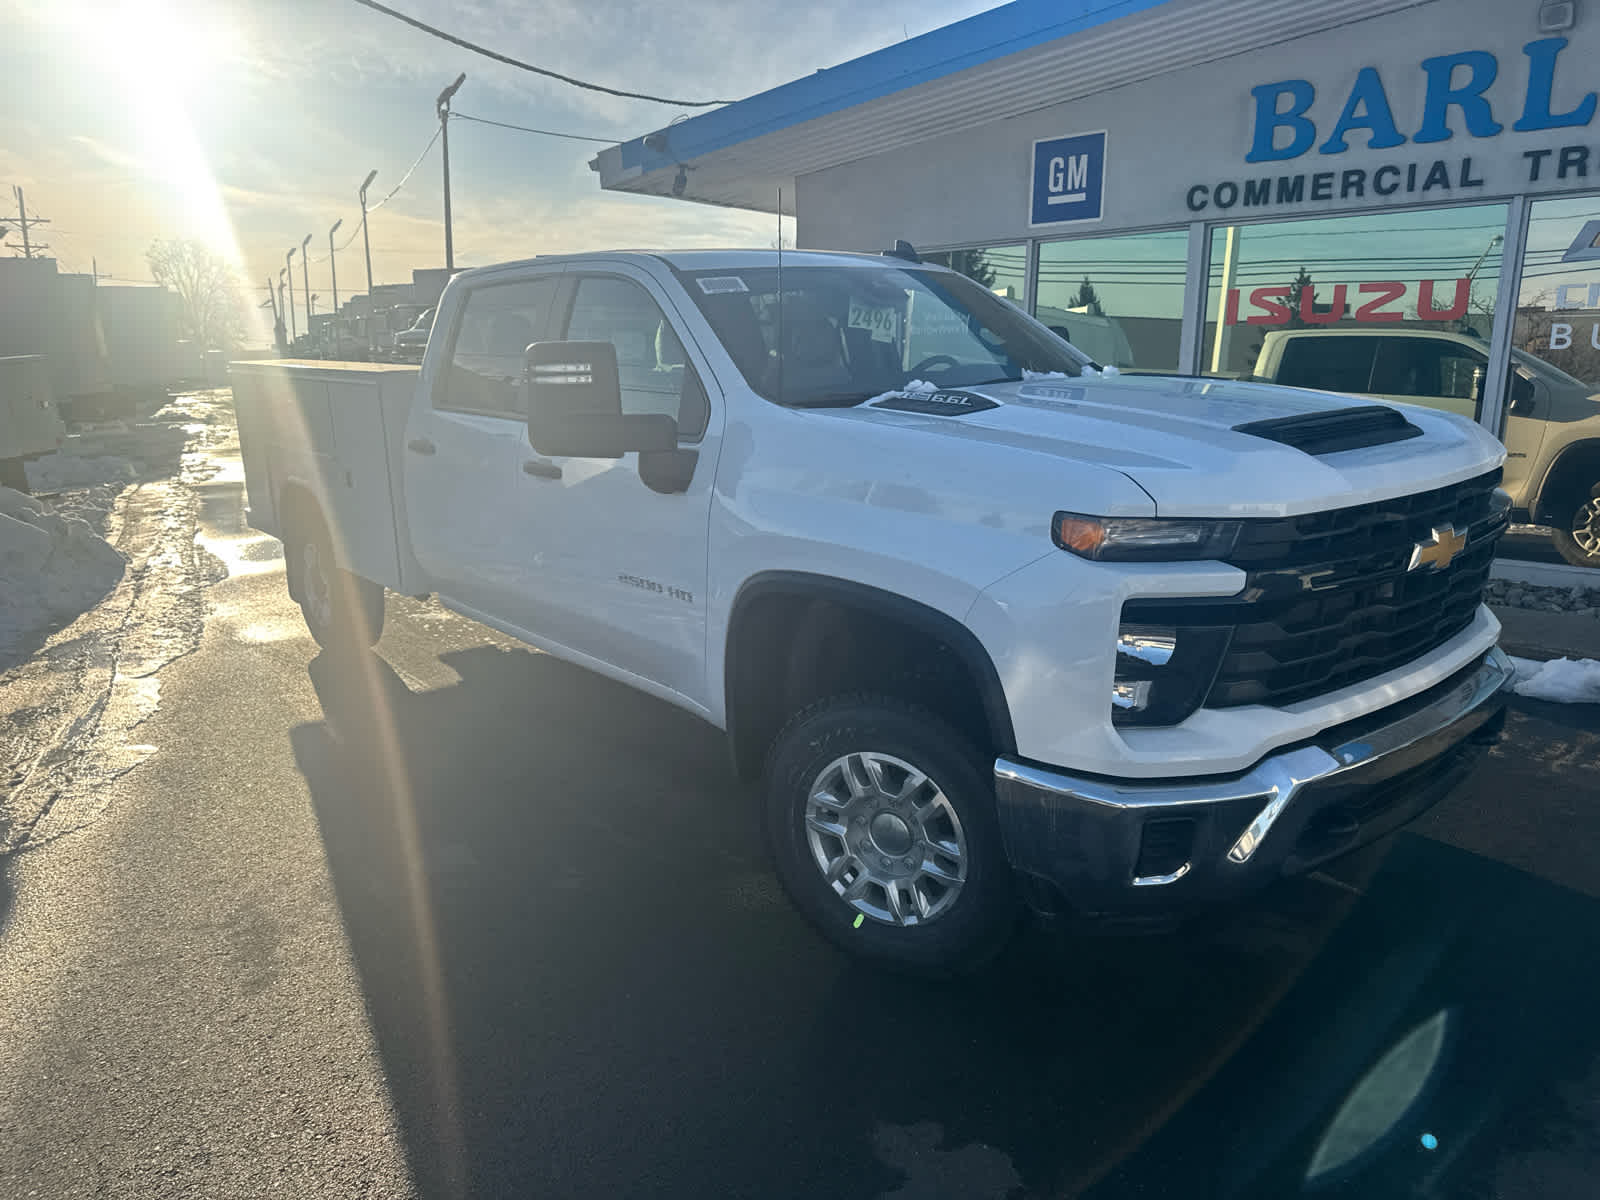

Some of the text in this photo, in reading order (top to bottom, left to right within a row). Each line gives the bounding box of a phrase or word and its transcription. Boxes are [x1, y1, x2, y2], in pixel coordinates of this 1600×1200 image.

[1245, 36, 1598, 164] BARL
[1048, 155, 1088, 193] GM
[1186, 145, 1600, 212] COMMERCIAL TR
[851, 308, 892, 330] 2496
[1225, 278, 1472, 326] ISUZU
